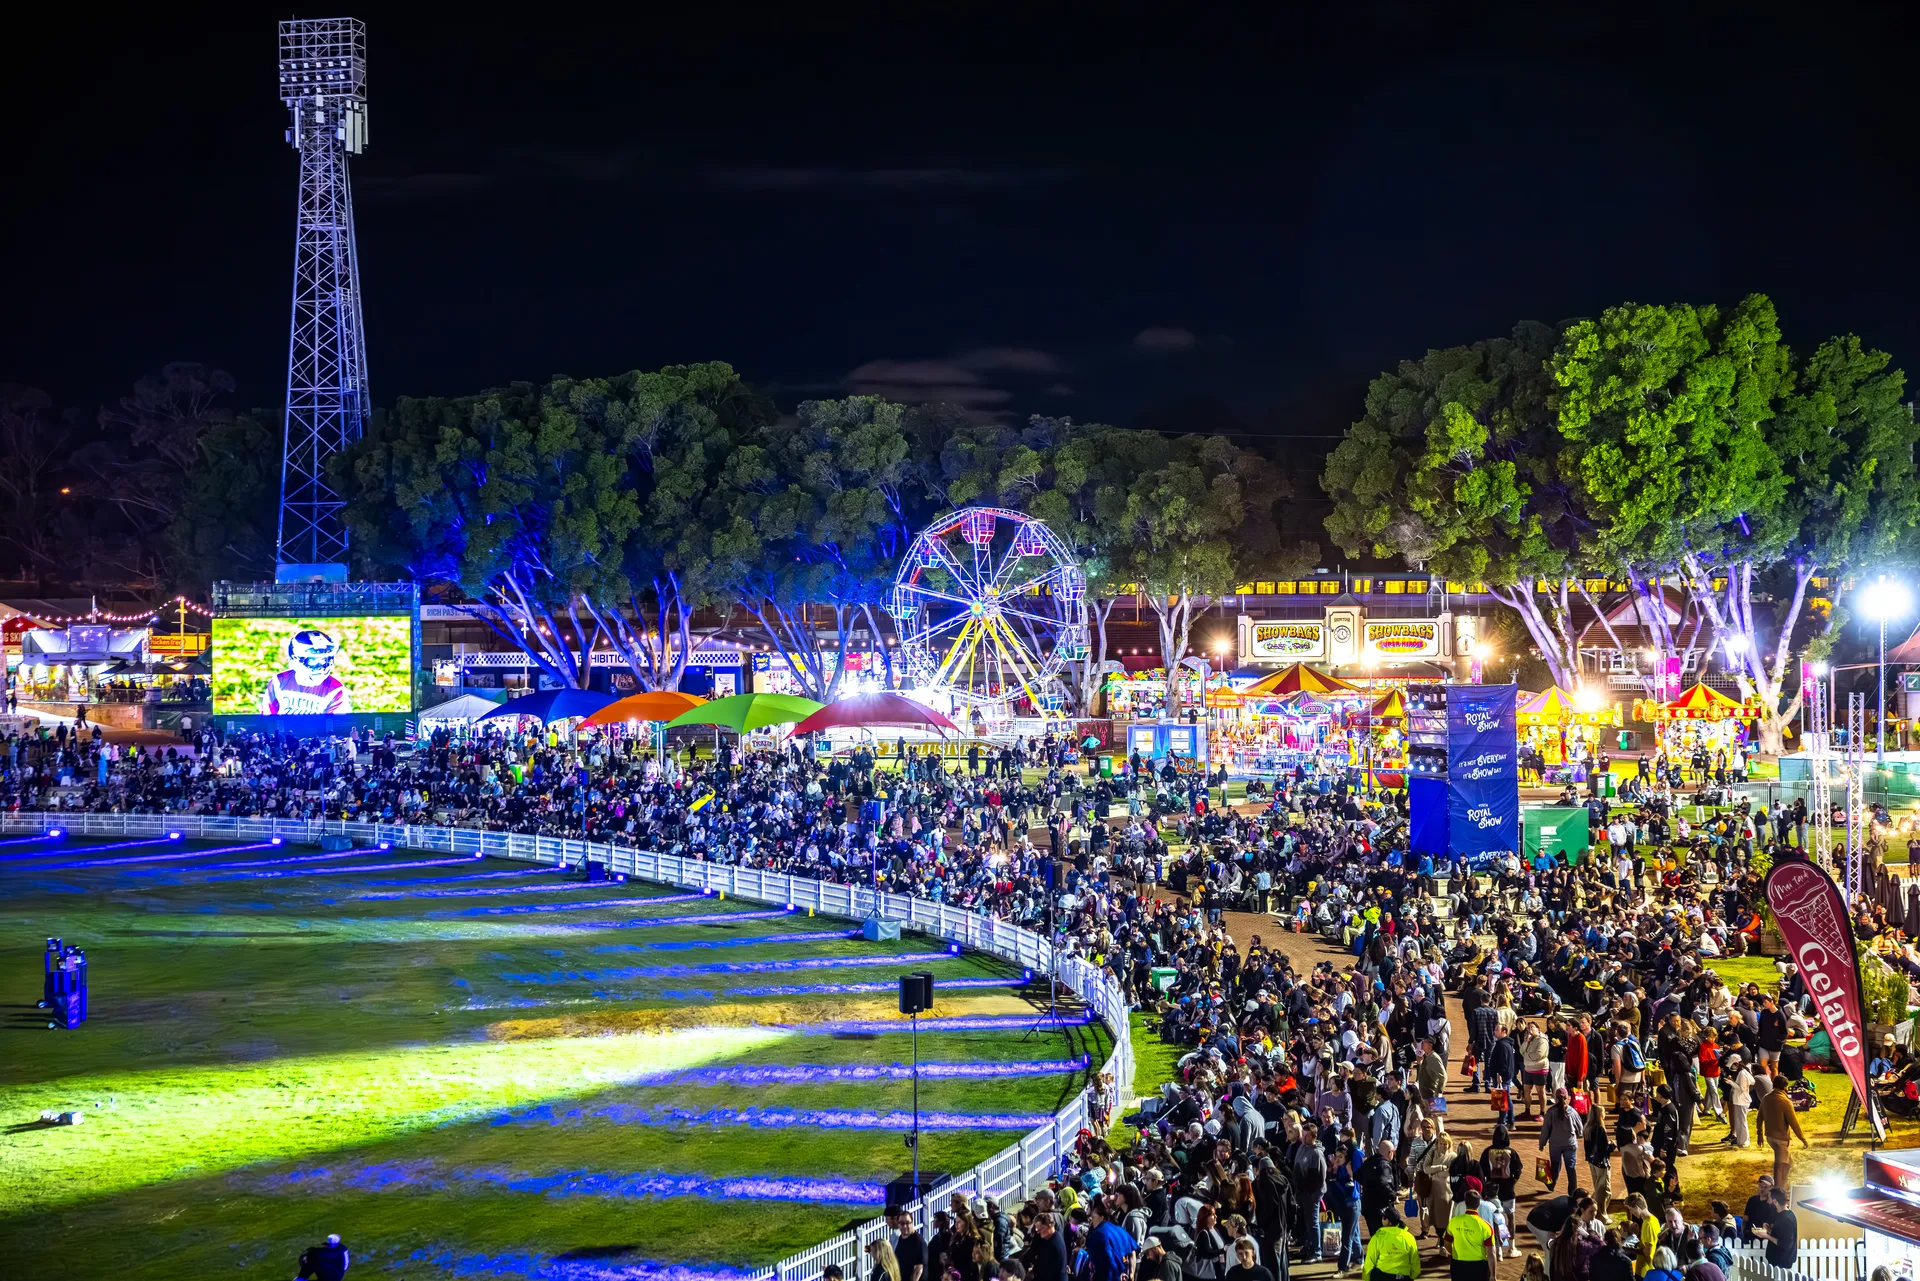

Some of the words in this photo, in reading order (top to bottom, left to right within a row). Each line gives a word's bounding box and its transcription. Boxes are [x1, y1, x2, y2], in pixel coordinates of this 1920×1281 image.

[426, 608, 442, 617] RICH
[1256, 625, 1320, 643] SHOWBAGS
[1368, 624, 1434, 641] SHOWBAGS
[578, 654, 629, 664] EHIBITIO
[1465, 711, 1491, 725] ROYAL
[1477, 719, 1500, 733] SHOW
[1471, 767, 1494, 780] SHOW
[1467, 807, 1491, 821] ROYAL
[1478, 816, 1502, 829] SHOW
[1799, 941, 1861, 1058] Gelato
